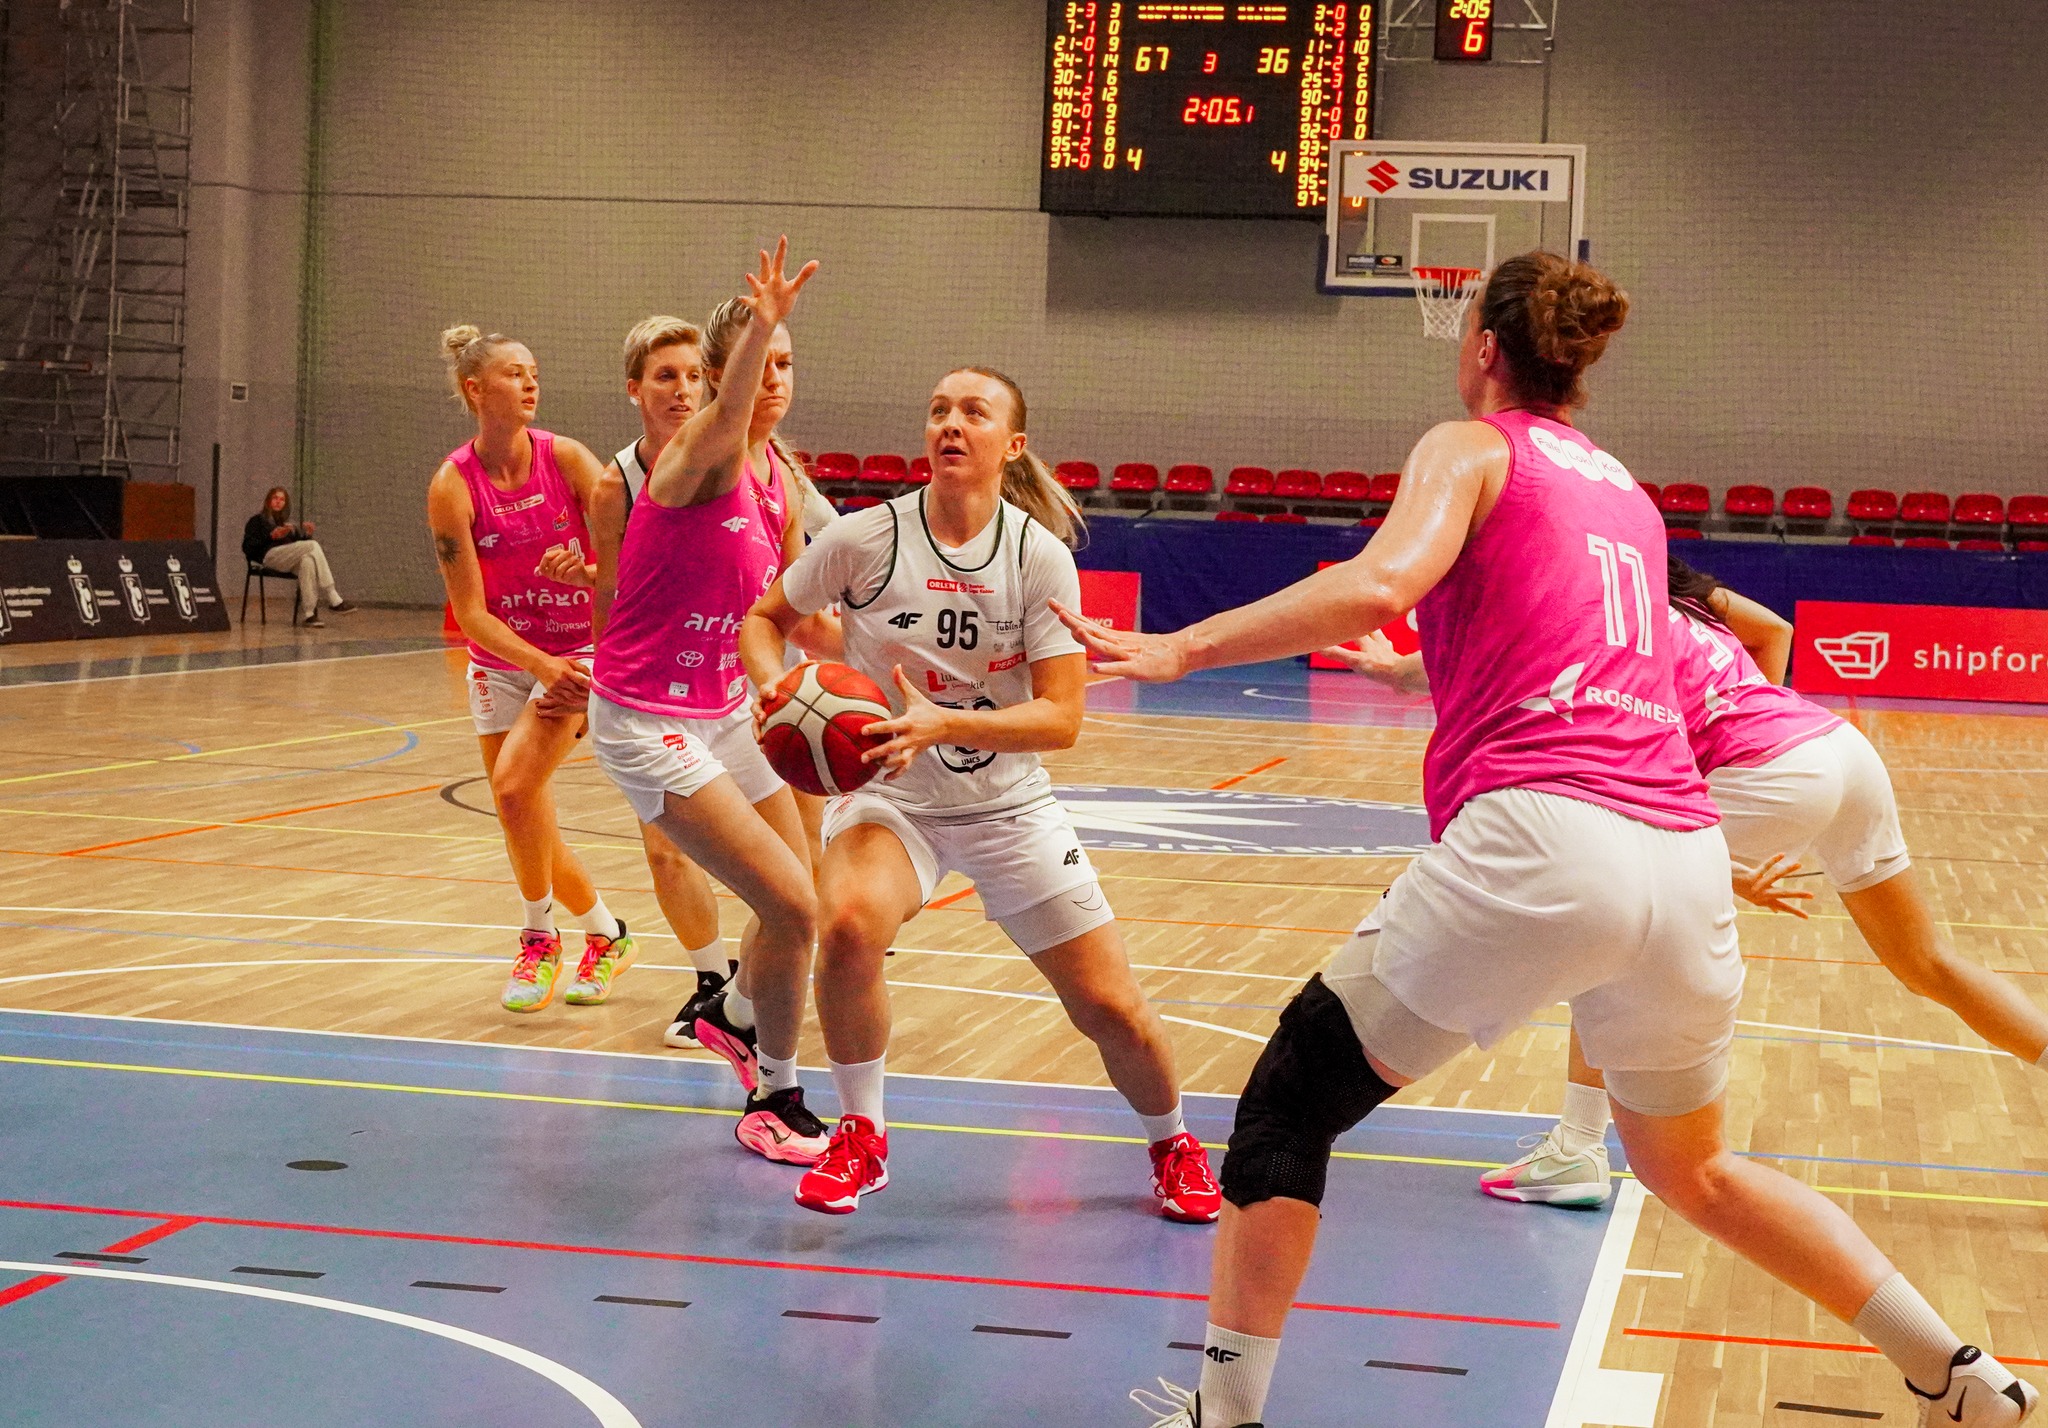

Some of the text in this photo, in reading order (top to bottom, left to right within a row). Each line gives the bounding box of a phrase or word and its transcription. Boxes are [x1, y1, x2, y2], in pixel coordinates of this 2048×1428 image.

[1110, 2, 1121, 18] 3
[1359, 4, 1372, 21] 0
[1109, 19, 1120, 35] 0
[1359, 22, 1371, 38] 9
[1109, 36, 1120, 52] 9
[1464, 22, 1484, 52] 6
[1353, 39, 1370, 55] 10
[1103, 53, 1119, 68] 14
[1135, 46, 1170, 72] 67
[1203, 53, 1218, 73] 3
[1257, 48, 1290, 74] 36
[1357, 56, 1369, 72] 2
[1106, 69, 1118, 85] 6
[1356, 72, 1368, 88] 6
[1102, 86, 1118, 102] 12
[1356, 90, 1368, 106] 0
[1106, 103, 1118, 119] 9
[1355, 107, 1367, 123] 0
[1105, 120, 1116, 136] 6
[1354, 123, 1366, 140] 0
[1104, 136, 1116, 153] 8
[1103, 153, 1115, 170] 0
[1127, 148, 1143, 171] 4
[1271, 150, 1287, 173] 4
[1408, 167, 1549, 191] SUZUKI
[721, 516, 749, 533] 4F
[478, 534, 500, 548] 4F
[888, 609, 979, 651] 4F 95
[1914, 642, 2048, 677] shipfor
[961, 756, 980, 766] UMCS
[1206, 1346, 1241, 1364] 4F
